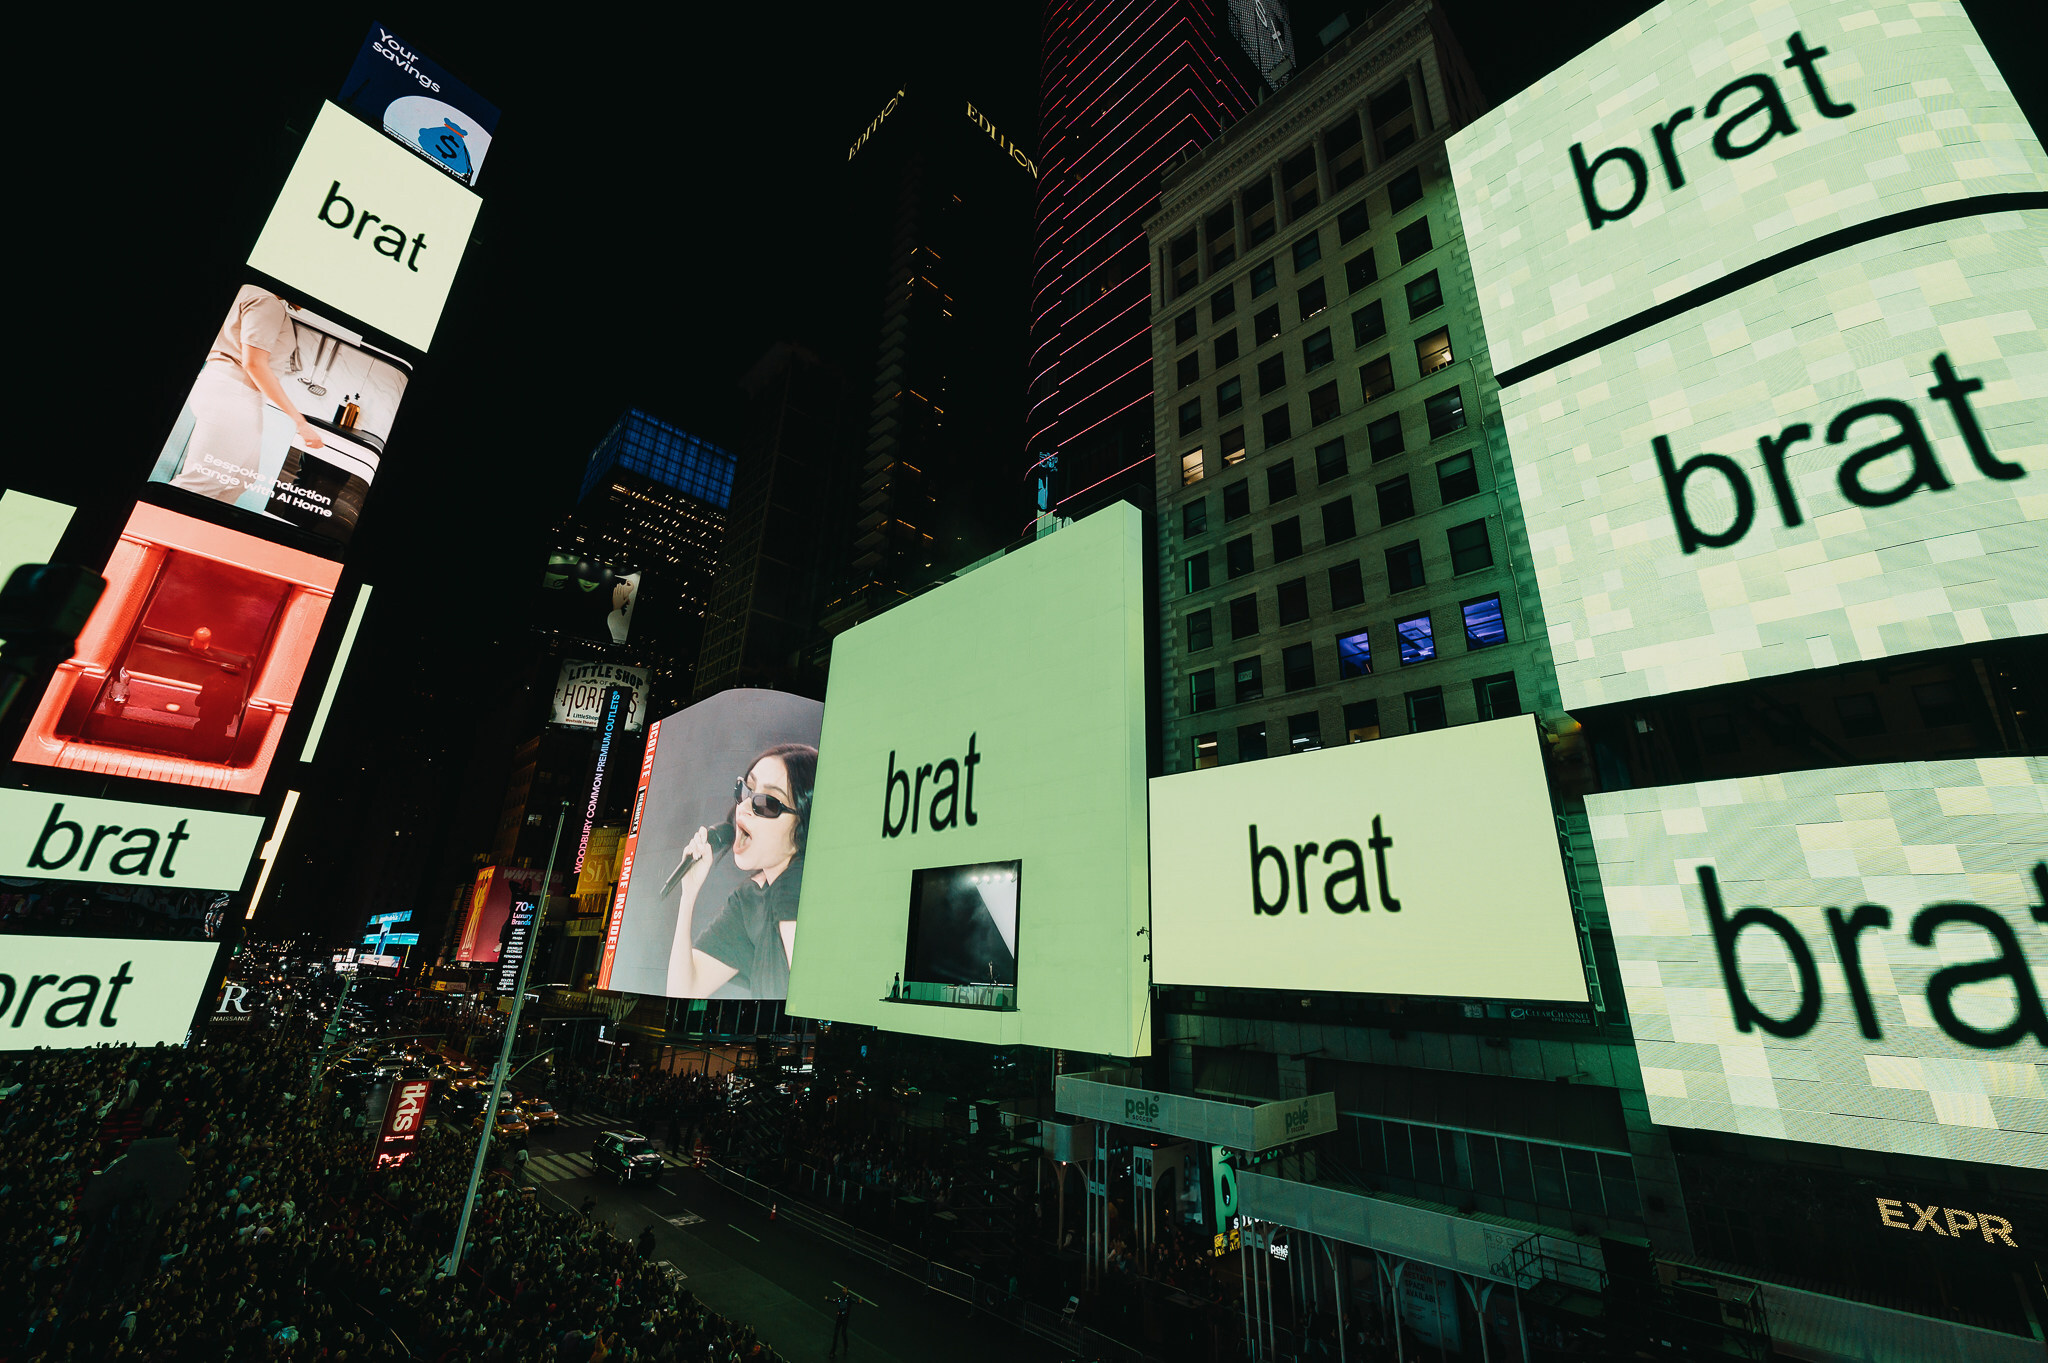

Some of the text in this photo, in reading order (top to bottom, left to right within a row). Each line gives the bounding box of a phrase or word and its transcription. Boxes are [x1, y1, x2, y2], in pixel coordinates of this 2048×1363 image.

[372, 41, 441, 93] savings
[380, 28, 419, 63] Your
[1569, 31, 1856, 230] brat
[317, 180, 427, 273] brat
[204, 453, 332, 506] Bespoke Induction
[1651, 352, 2027, 555] brat
[192, 463, 333, 518] Range with AI Home
[568, 665, 644, 690] LITTLE SHOP
[574, 819, 593, 874] WOODBURY
[586, 773, 603, 819] COMMON
[596, 732, 613, 773] PREMIUM
[881, 731, 981, 839] brat
[26, 802, 190, 879] brat
[1248, 814, 1402, 917] brat
[512, 912, 533, 920] Luxury
[515, 901, 535, 912] 70+
[607, 893, 626, 950] INSIDE!
[0, 960, 134, 1029] rat
[215, 985, 252, 1013] R
[392, 1083, 427, 1132] tkts
[1875, 1197, 2019, 1248] EXPR
